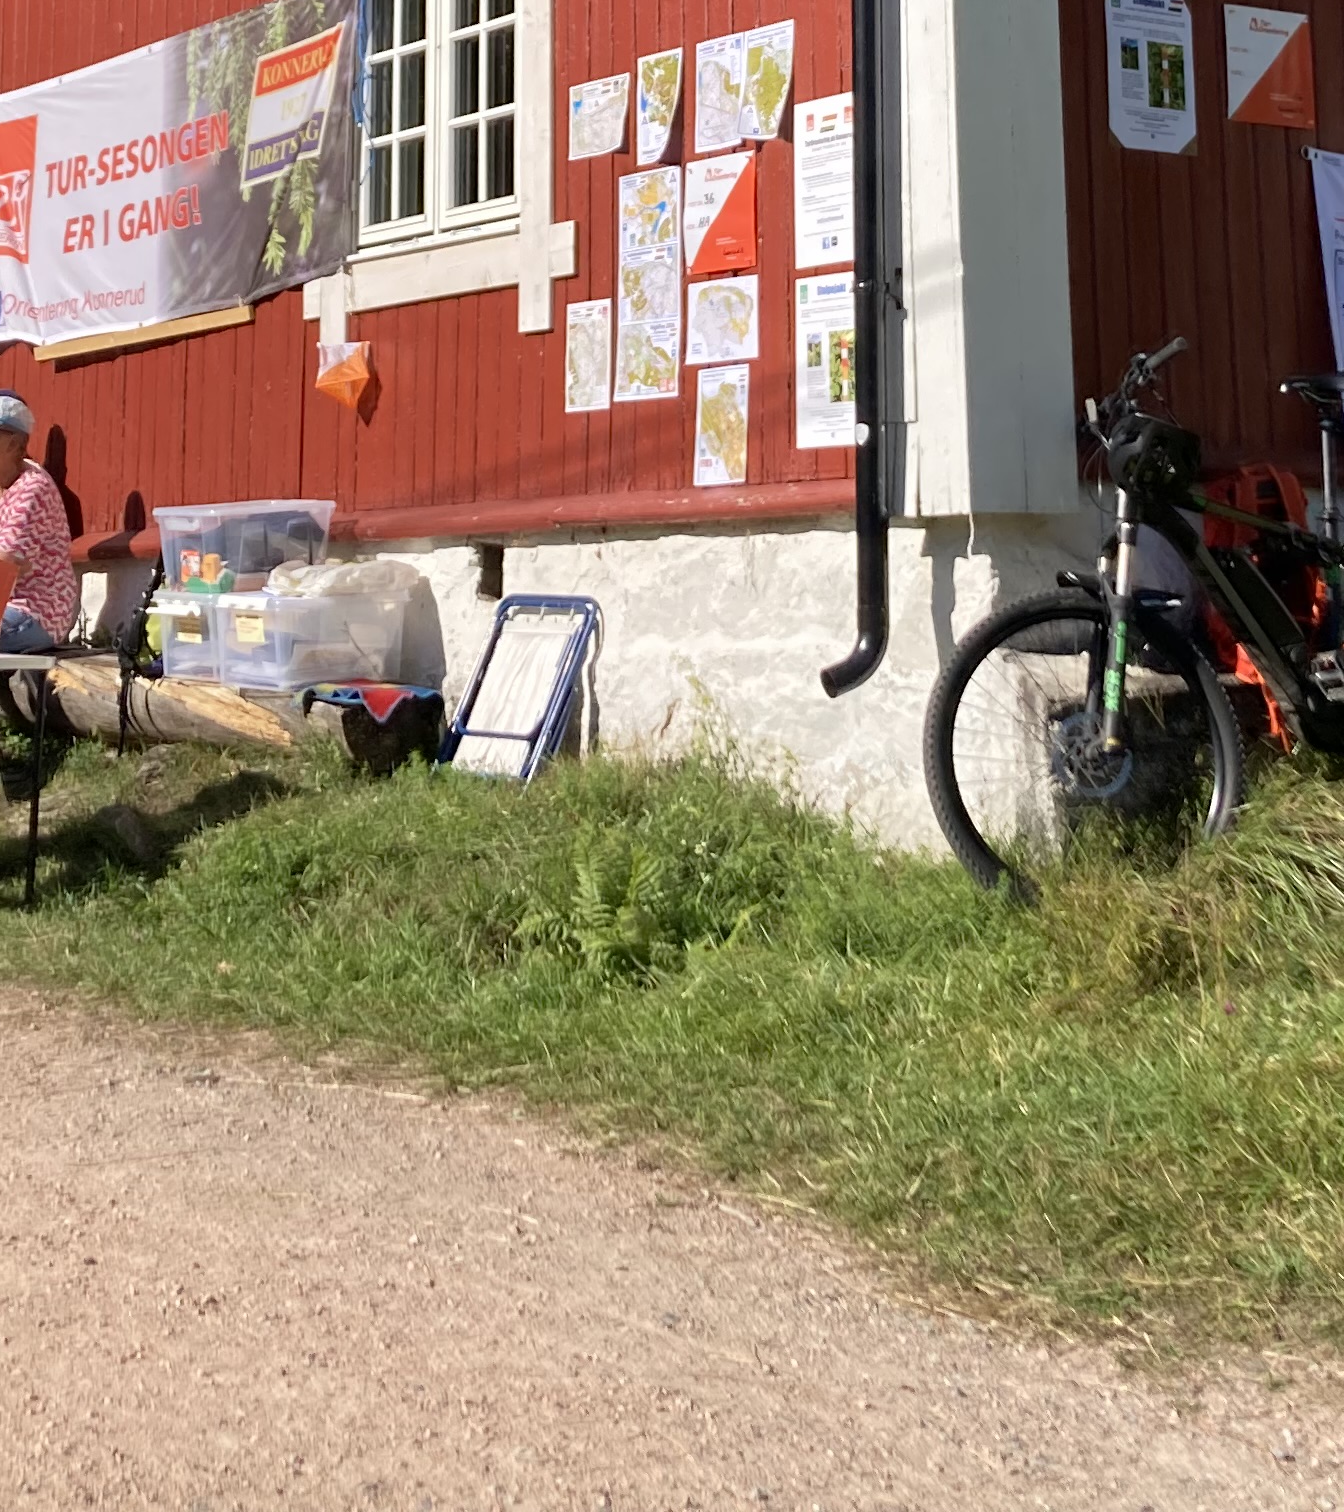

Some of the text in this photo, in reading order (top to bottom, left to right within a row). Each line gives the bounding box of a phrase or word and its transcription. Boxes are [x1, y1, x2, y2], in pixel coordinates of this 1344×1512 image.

[45, 110, 229, 198] TUR-SESONGEN
[63, 213, 95, 254] ER
[103, 209, 109, 246] I
[118, 184, 201, 243] GANG!
